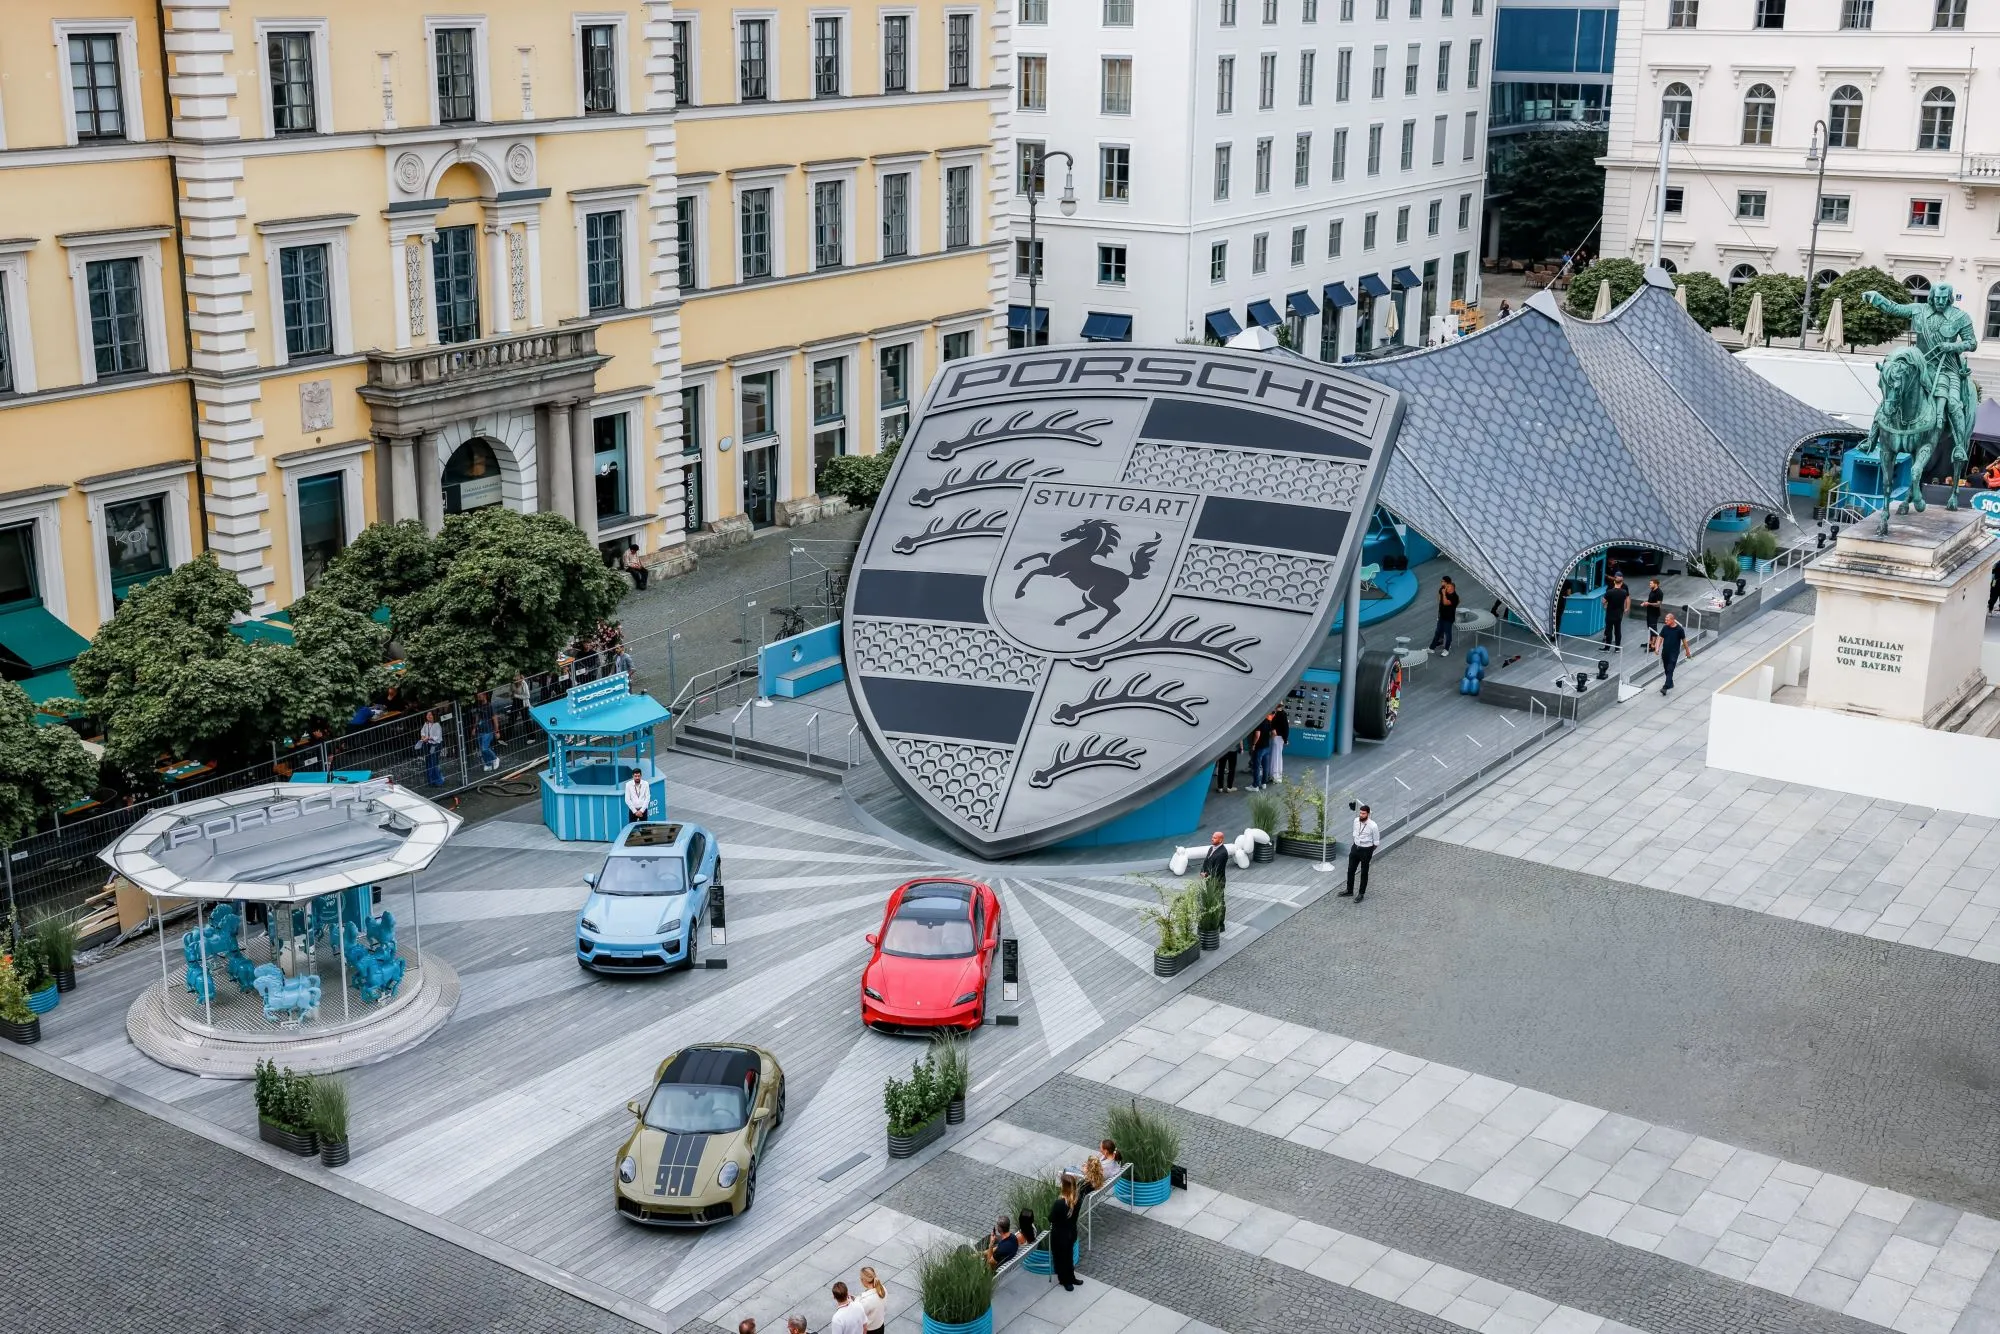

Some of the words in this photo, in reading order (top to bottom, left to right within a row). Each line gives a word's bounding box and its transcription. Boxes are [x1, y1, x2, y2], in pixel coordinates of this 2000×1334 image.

[947, 356, 1372, 427] PORSCHE
[687, 472, 695, 501] since
[1033, 489, 1189, 517] STUTTGART
[688, 504, 696, 529] 1965
[1838, 634, 1904, 651] MAXIMILIAN
[1836, 657, 1856, 666] VON
[1861, 660, 1902, 673] BAYERN
[1837, 646, 1903, 662] CHURFUERST
[577, 684, 624, 703] PORSCHE
